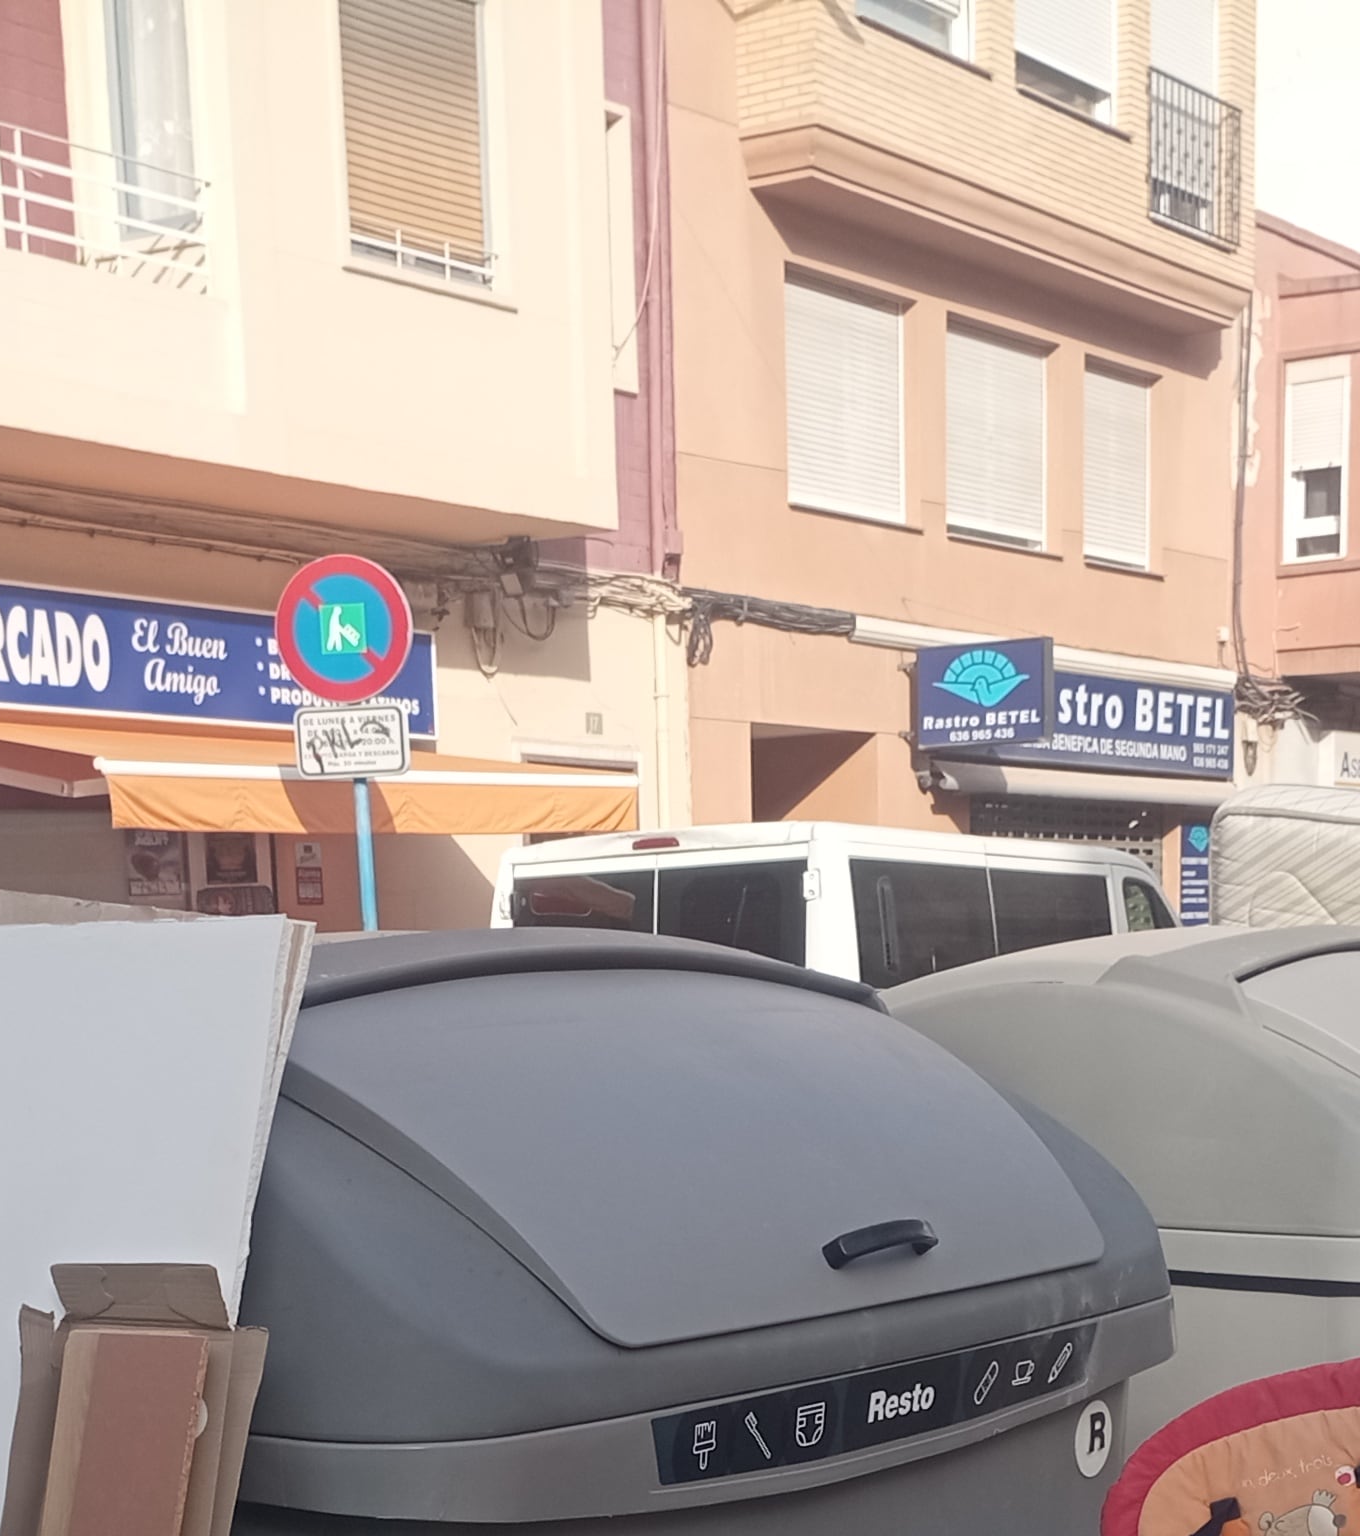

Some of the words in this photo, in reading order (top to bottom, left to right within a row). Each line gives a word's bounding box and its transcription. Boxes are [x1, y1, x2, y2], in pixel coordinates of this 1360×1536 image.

[131, 618, 159, 653] El
[166, 622, 228, 661] Buen
[143, 658, 221, 706] Amigo
[923, 715, 980, 730] Rastro
[985, 709, 1041, 726] BETEL
[1057, 683, 1124, 730] stro
[1134, 687, 1230, 740] BETEL
[971, 728, 992, 740] 965
[1100, 736, 1114, 755] DE
[1115, 739, 1159, 760] SEGUNDA
[1160, 745, 1188, 763] MANO
[867, 1382, 936, 1424] Resto
[1087, 1411, 1106, 1455] R
